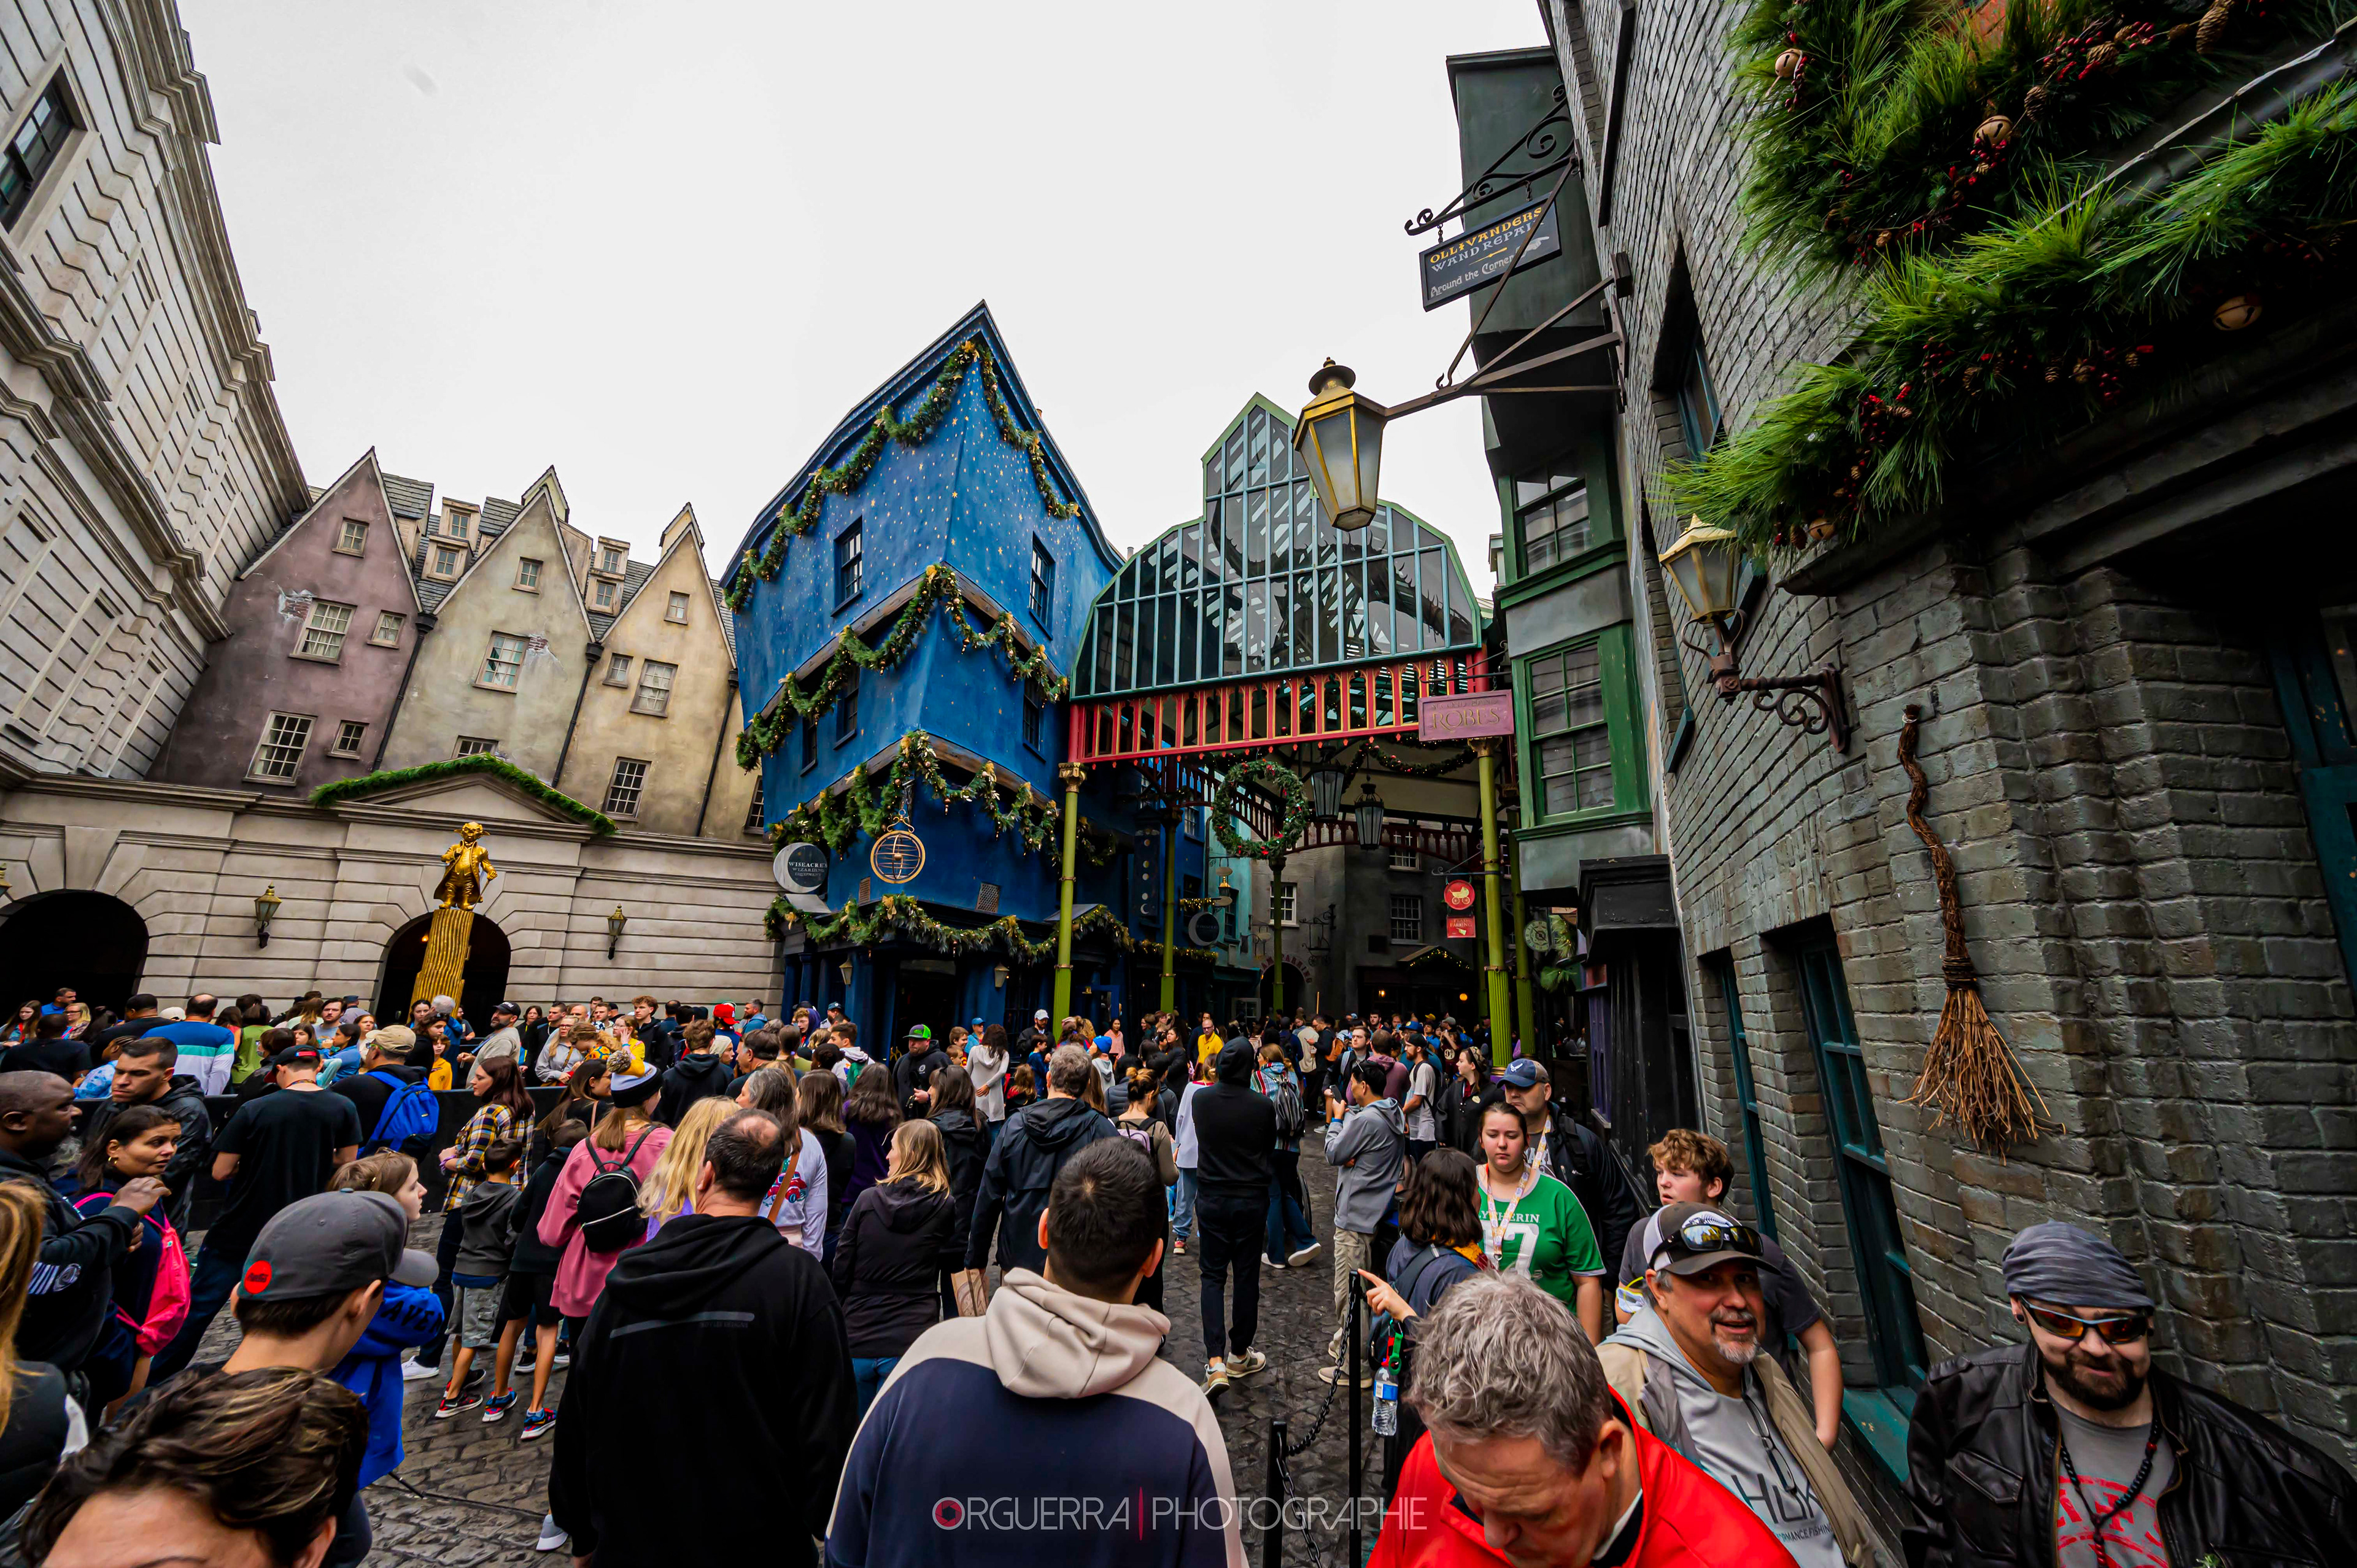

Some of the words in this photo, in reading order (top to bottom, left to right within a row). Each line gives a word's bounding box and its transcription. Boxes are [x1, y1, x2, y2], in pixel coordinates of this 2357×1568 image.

[1430, 207, 1542, 264] OLLIVANDERS
[1431, 246, 1480, 272] WAND
[1482, 219, 1544, 251] REPAI
[1430, 276, 1463, 298] Around
[1465, 270, 1479, 281] the
[1481, 255, 1514, 274] Corner
[1433, 707, 1500, 733] ROBES
